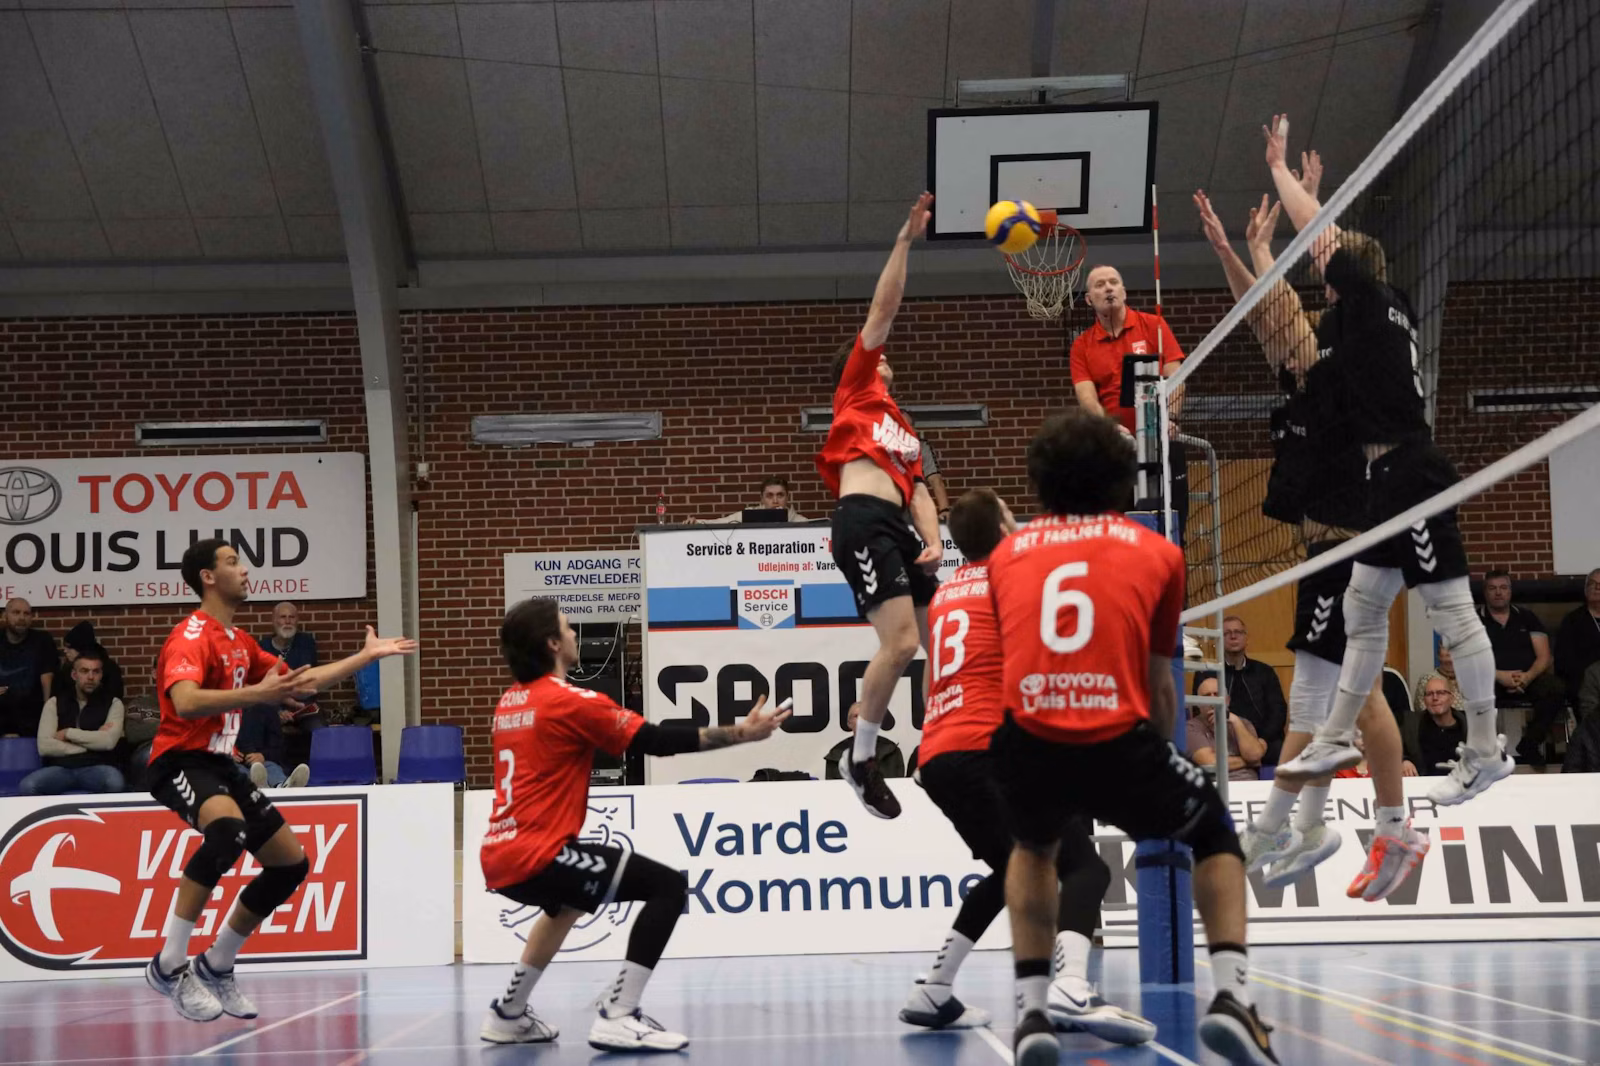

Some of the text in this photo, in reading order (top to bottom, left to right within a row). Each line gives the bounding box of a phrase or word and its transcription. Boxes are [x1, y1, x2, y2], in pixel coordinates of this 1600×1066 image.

[78, 471, 308, 513] TOYOTA
[0, 530, 140, 574] OUIS
[686, 543, 732, 556] Service
[736, 542, 745, 555] &
[749, 541, 815, 556] Reparation
[534, 560, 561, 571] KUN
[567, 559, 622, 570] ADGANG
[758, 562, 800, 573] Udlejning
[802, 562, 814, 571] af:
[45, 584, 105, 599] VEJEN
[135, 582, 199, 597] ESBJE
[248, 578, 309, 594] VARDE
[608, 592, 640, 602] MEDFØ
[597, 605, 615, 613] FRA
[744, 589, 788, 612] BOSCH Service
[1040, 561, 1094, 653] 6
[933, 609, 970, 682] 13
[1048, 672, 1117, 690] TOYOTA
[1069, 690, 1119, 710] Lund
[493, 749, 515, 817] 3
[673, 809, 848, 857] Varde
[129, 881, 346, 939] LIGEN
